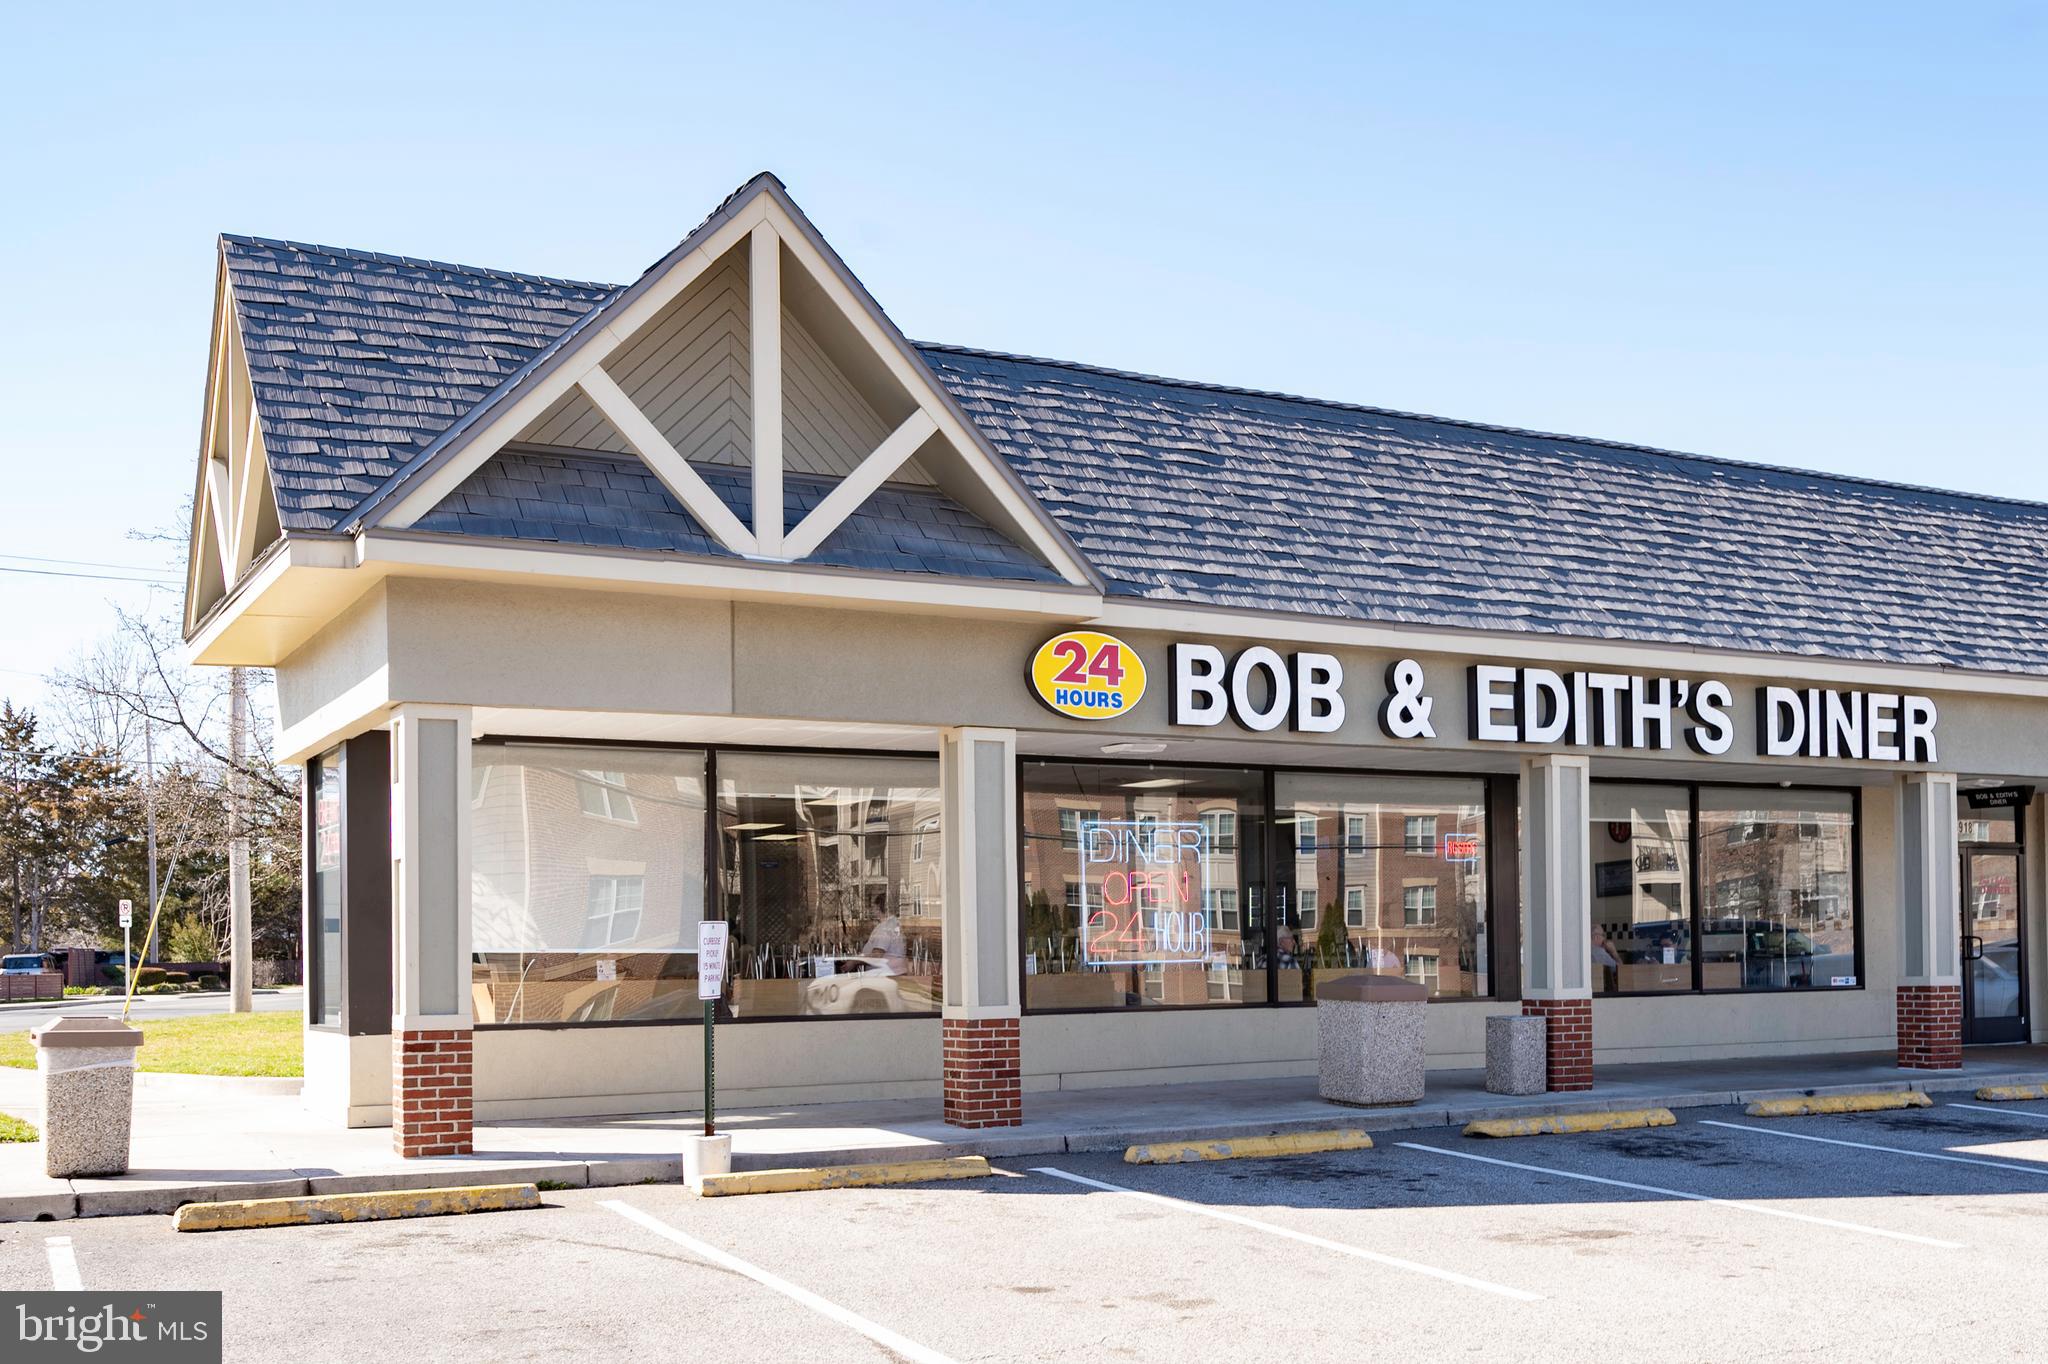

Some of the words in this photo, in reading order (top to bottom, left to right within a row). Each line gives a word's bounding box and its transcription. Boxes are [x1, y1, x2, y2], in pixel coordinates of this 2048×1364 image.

[1052, 639, 1125, 687] 24
[1056, 688, 1123, 709] HOURS
[1172, 642, 1346, 733] BOB
[1382, 658, 1438, 739] &
[1472, 664, 1735, 756] EDITH'S
[1761, 685, 1939, 763] DINER
[1089, 829, 1201, 864] DINER
[1104, 871, 1189, 905] OPEN
[1088, 910, 1148, 953] 24
[1154, 911, 1205, 953] HOUR
